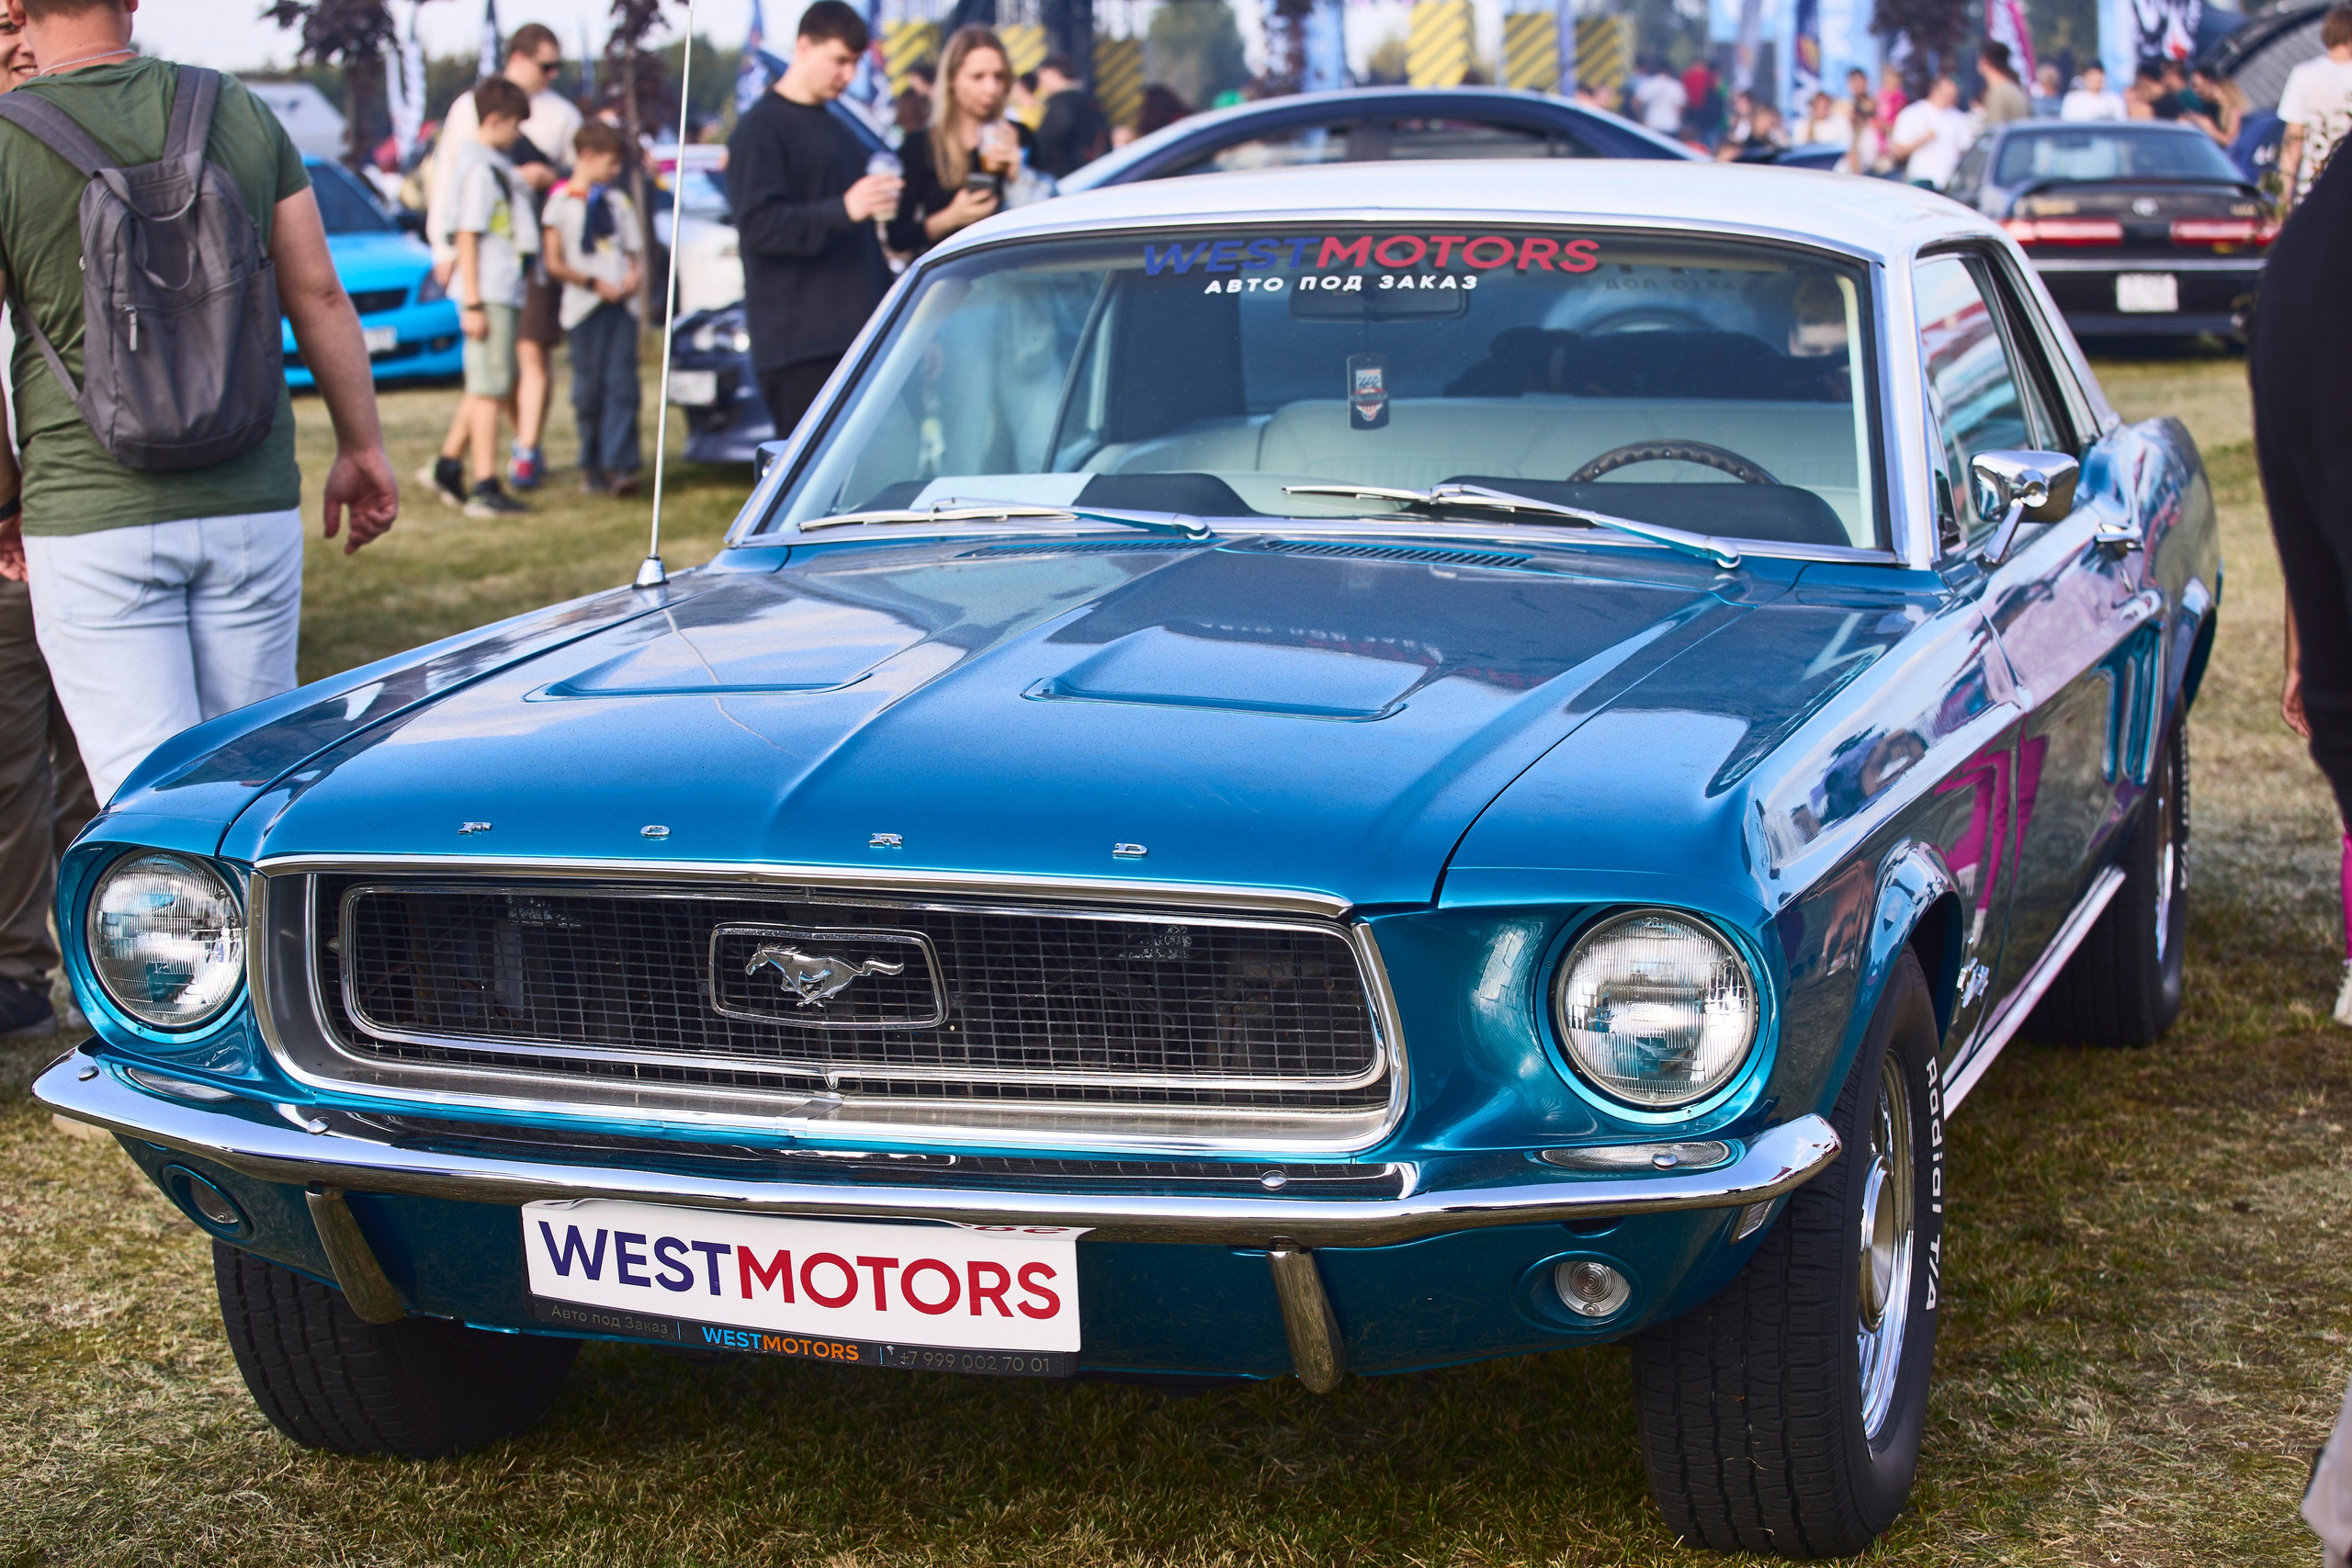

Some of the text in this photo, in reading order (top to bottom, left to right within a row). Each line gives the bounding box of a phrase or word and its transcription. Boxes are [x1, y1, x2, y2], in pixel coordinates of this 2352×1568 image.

[1144, 234, 1600, 276] WESTMOTORS
[1204, 275, 1478, 295] АВТО ПОД ЗАКАЗ
[458, 821, 1148, 860] FORD
[1926, 1056, 1943, 1311] Radial T/A
[537, 1220, 1062, 1320] WESTMOTORS
[551, 1304, 669, 1335] Авто под Заказ
[702, 1326, 860, 1361] WESTMOTORS
[899, 1350, 1050, 1372] +7 999 002 70 01
